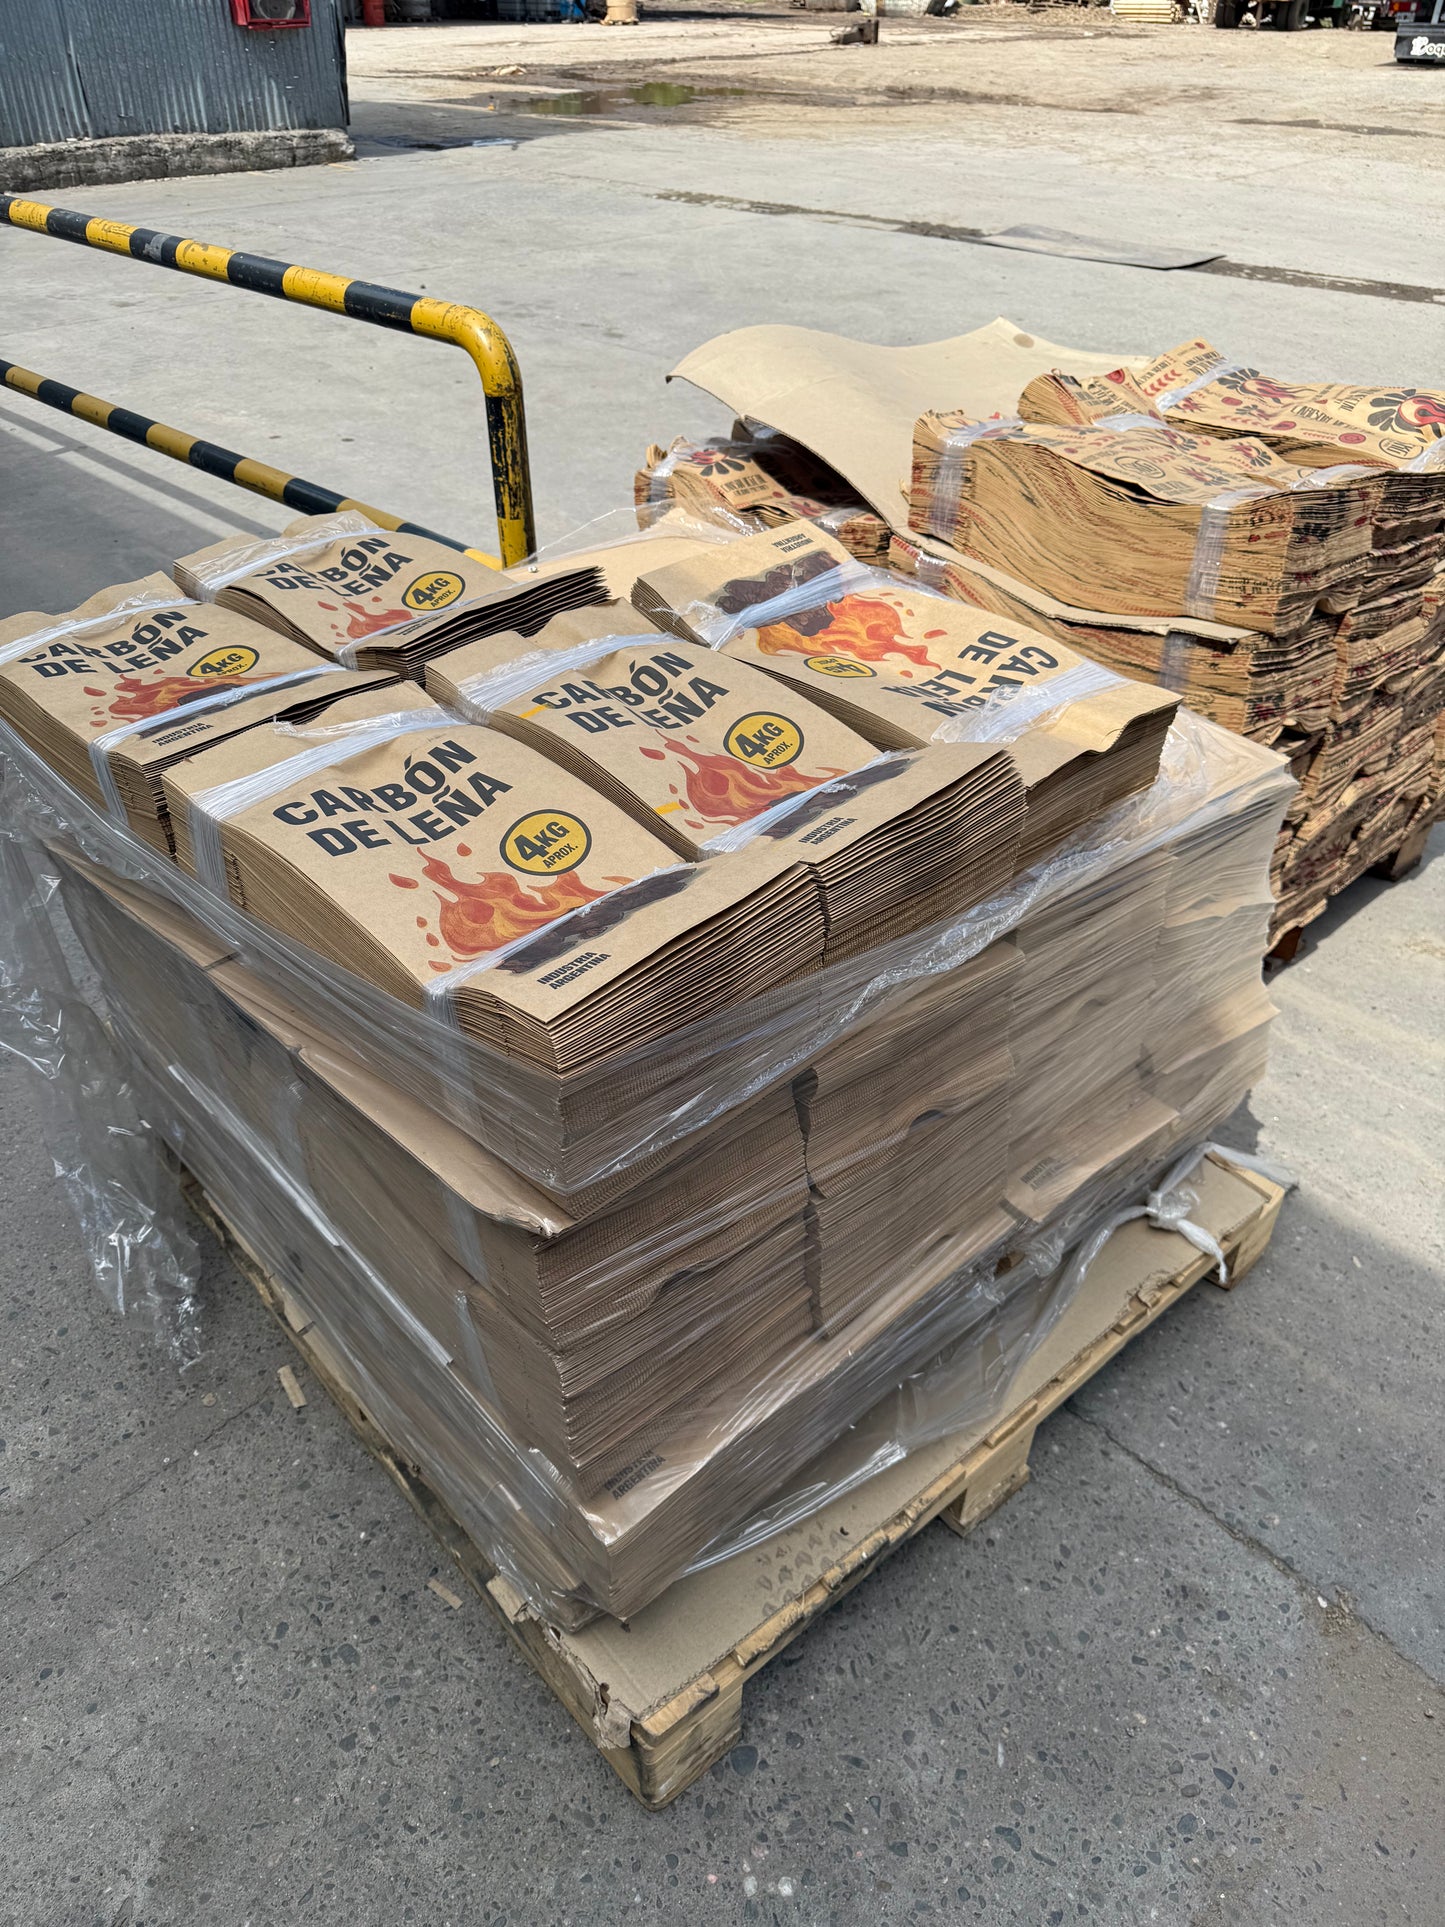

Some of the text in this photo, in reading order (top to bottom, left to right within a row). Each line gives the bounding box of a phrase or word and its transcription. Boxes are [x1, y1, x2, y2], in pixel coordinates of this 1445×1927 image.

[265, 552, 414, 597] DE LEÑA
[411, 577, 451, 605] 4KG
[430, 589, 456, 607] APROX.
[31, 625, 209, 678] DE LEÑA
[200, 652, 244, 674] 4KG
[957, 630, 1020, 665] DE
[565, 676, 730, 734] DE LEÑA
[151, 722, 205, 744] INDUSTRIA
[158, 724, 214, 747] ARGENTINA
[734, 720, 785, 759] 4KG
[763, 742, 793, 765] APROX.
[272, 739, 478, 826] CARBÓN
[306, 771, 513, 857] DE LEÑA
[798, 816, 845, 844] INDUSTRIA
[810, 817, 859, 845] ARGENTINA
[513, 821, 570, 862] 4KG
[542, 843, 578, 870] APROX.
[536, 951, 598, 985] INDUSTRIA
[549, 953, 612, 990] ARGENTINA
[612, 1455, 666, 1501] ARGENTINA
